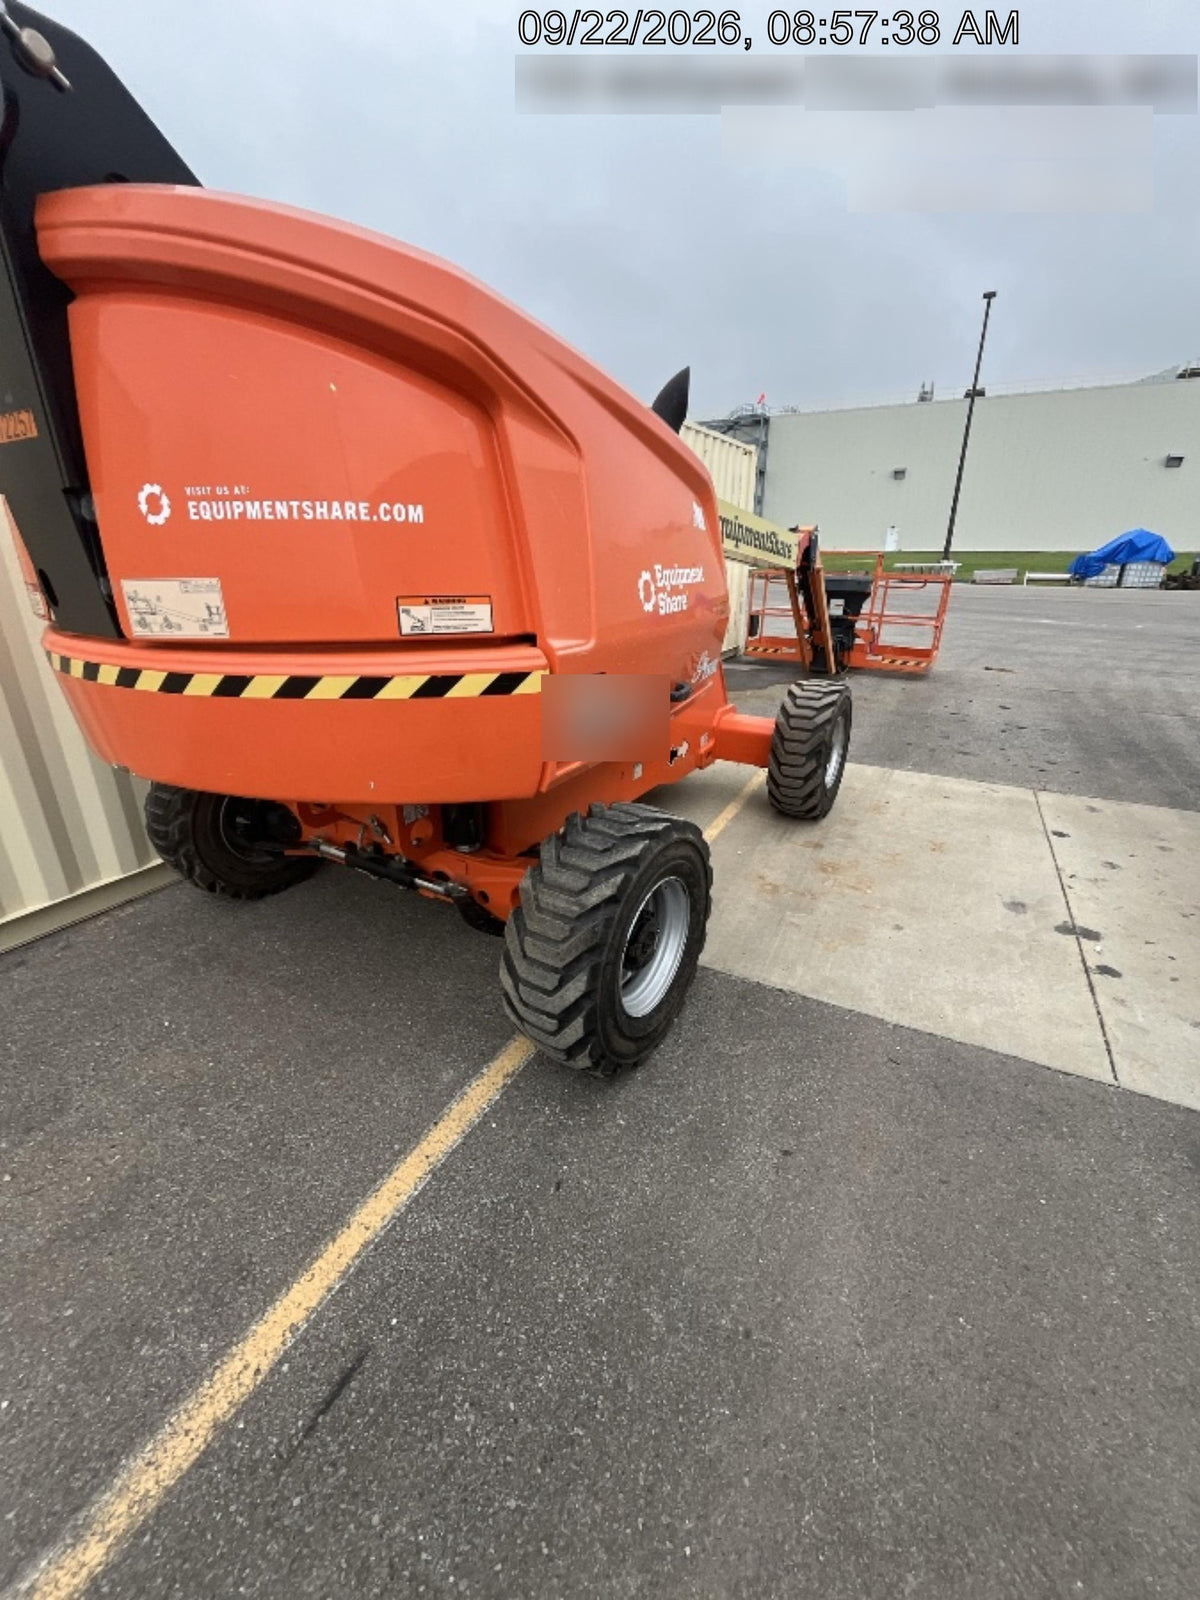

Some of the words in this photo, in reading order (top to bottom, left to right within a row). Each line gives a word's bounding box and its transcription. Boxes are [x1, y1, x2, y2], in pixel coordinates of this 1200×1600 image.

[184, 486, 211, 496] VISIT
[216, 486, 230, 495] US
[187, 500, 424, 523] EQUIPMENTSHARE.COM
[718, 515, 792, 559] quipmentShare
[658, 591, 688, 615] Share
